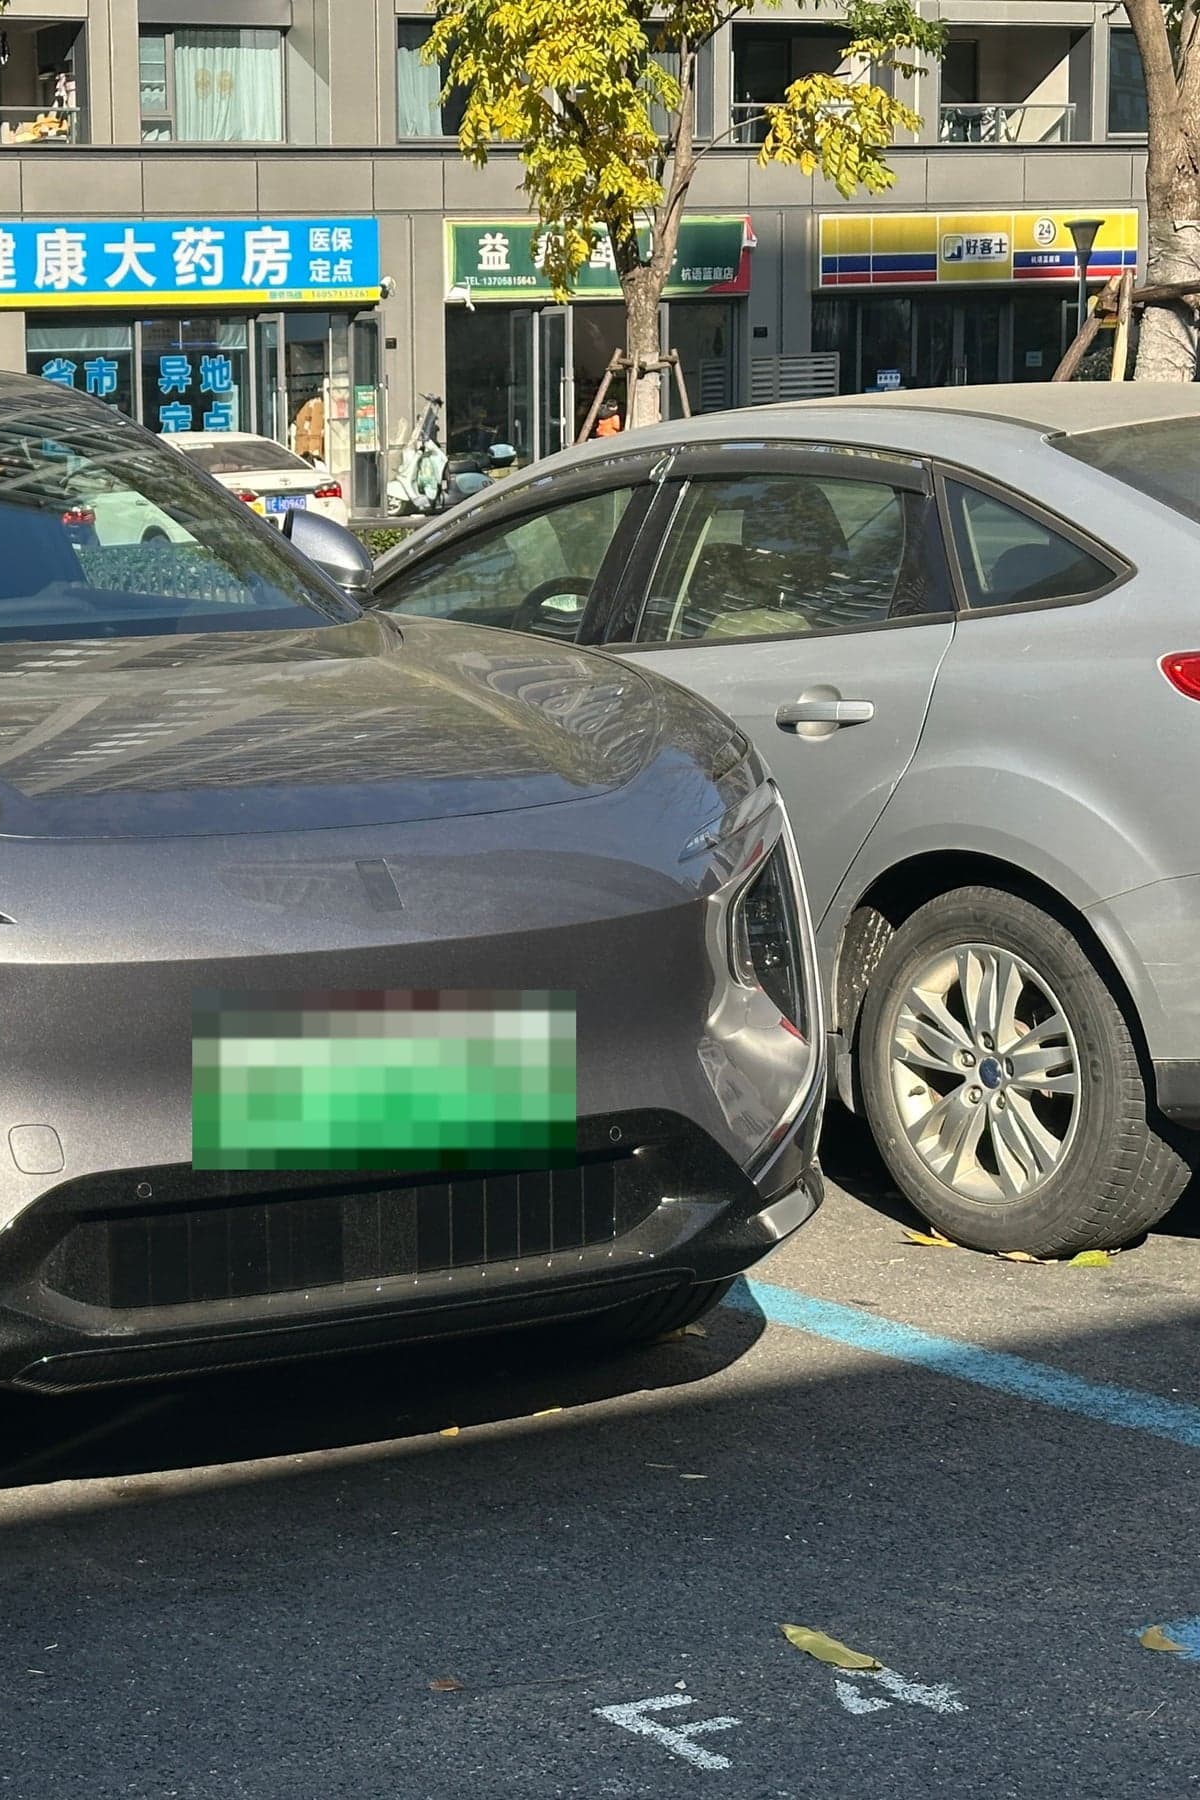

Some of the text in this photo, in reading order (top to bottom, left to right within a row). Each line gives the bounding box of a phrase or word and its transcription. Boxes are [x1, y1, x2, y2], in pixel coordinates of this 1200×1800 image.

[309, 227, 353, 252] 医保
[1038, 223, 1051, 236] 24
[965, 238, 1007, 255] 好客士
[309, 257, 353, 283] 定点
[41, 354, 233, 396] 省市 异地
